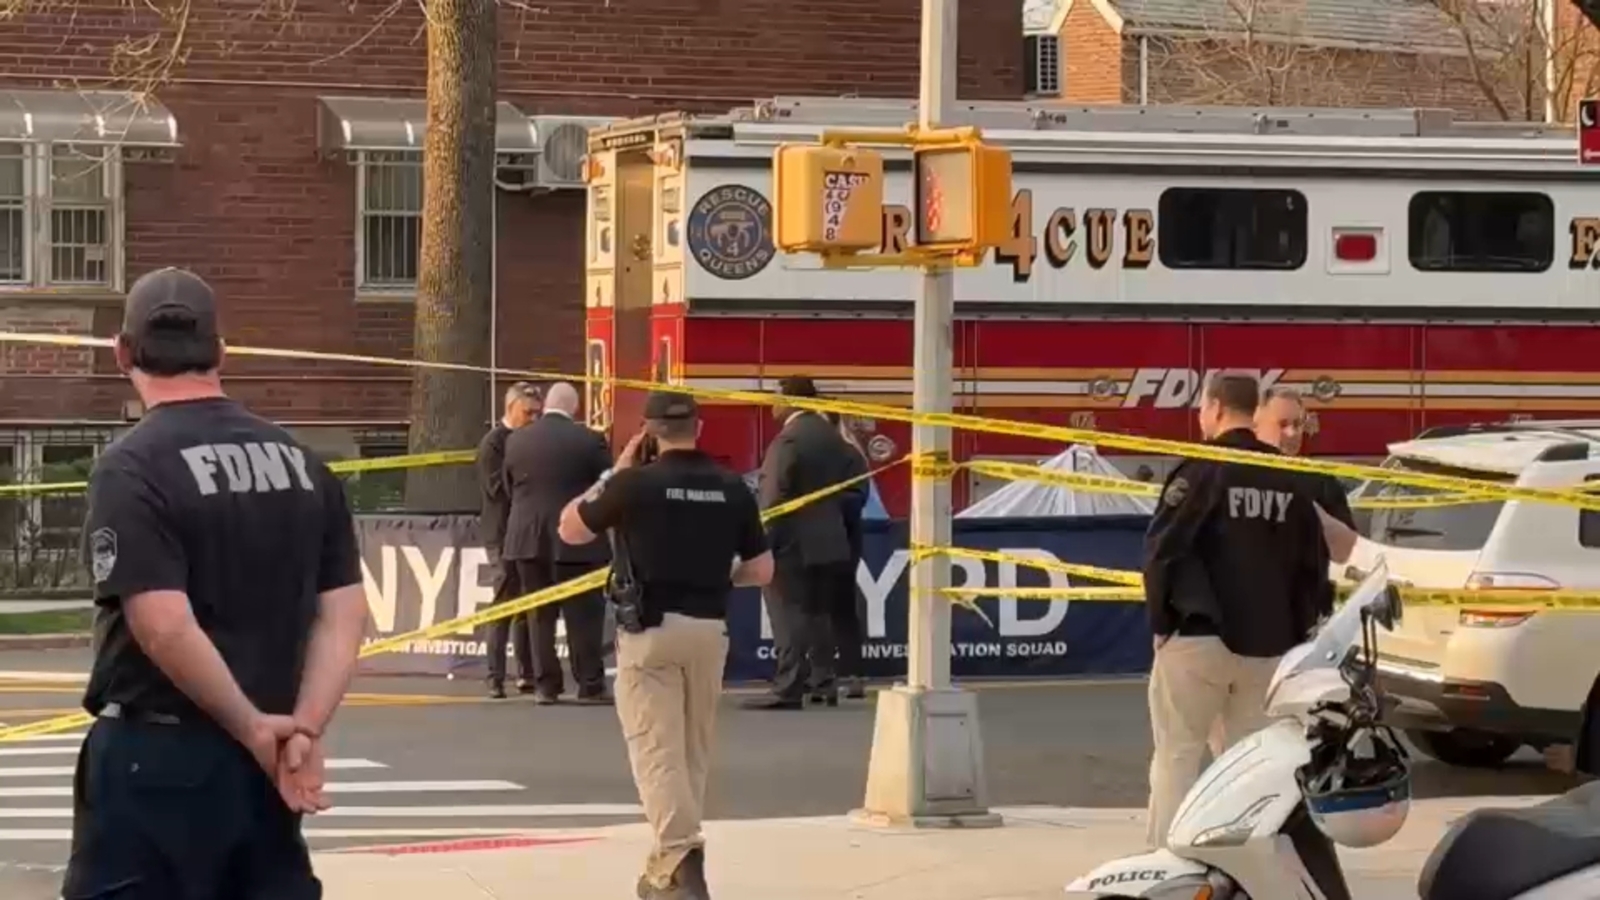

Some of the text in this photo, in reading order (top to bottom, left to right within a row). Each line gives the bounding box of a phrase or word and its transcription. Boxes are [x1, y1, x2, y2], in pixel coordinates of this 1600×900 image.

[700, 188, 771, 216] RESCUE
[700, 248, 768, 274] QUEENS
[727, 241, 738, 256] 4
[180, 442, 314, 496] FDNY
[360, 545, 496, 635] NYP
[760, 548, 1070, 638] YPD
[861, 642, 1067, 659] INVEATION SQUAD
[1087, 869, 1167, 891] POLICE
